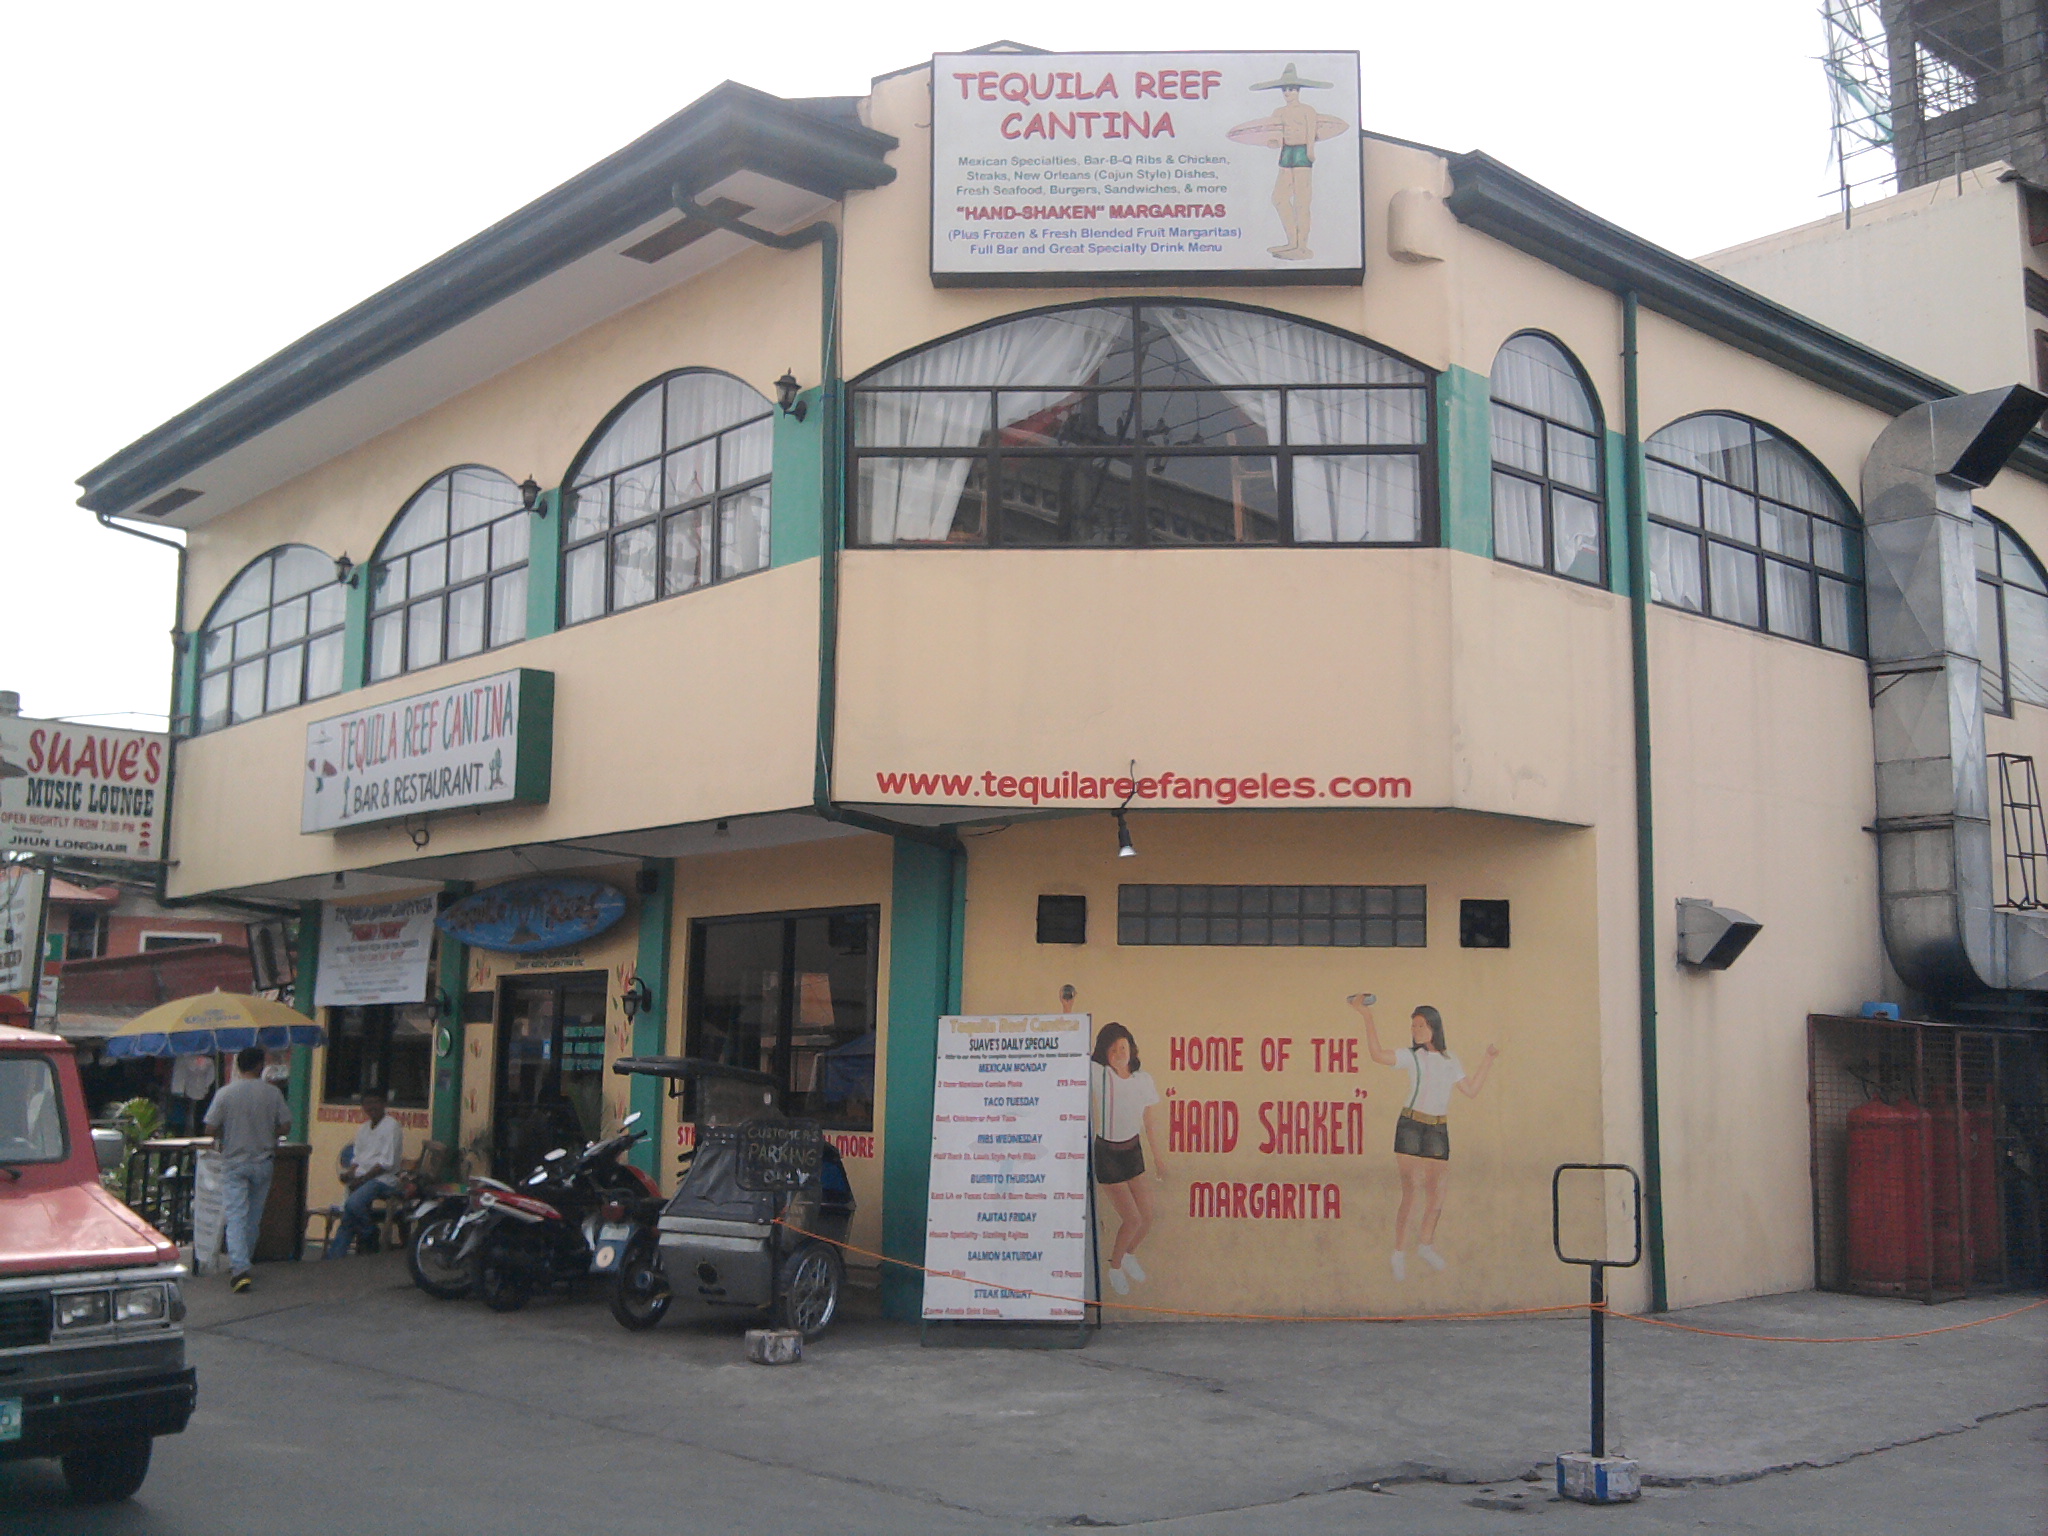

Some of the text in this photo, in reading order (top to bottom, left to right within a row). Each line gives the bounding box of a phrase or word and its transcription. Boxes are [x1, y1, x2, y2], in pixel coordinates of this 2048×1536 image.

[953, 70, 1222, 106] TEQUILA REEF
[1000, 111, 1175, 140] CANTINA
[958, 154, 1231, 168] Mexican Specialties, Bar-B-Q Ribs & Chicken,
[966, 168, 1219, 182] Steaks, New Orleans (Cajun Style) Dishes,
[956, 184, 1228, 198] Fresh Seafood, Burgers, Sandwiches, & more
[1109, 204, 1227, 219] MARGARITAS
[948, 227, 1242, 241] (Plus Frozen & Fresh Blended Fruit Margaritas)
[970, 242, 1223, 255] Full Bar and Great Specialty Drink Menu
[341, 681, 513, 775] TEQUILA REEF CANTINA
[27, 729, 162, 784] SUAVE'S
[354, 763, 484, 814] BAR & RESTAURANT
[876, 771, 1412, 805] www.tequilareefangeles.com
[26, 777, 154, 817] MUSIC LOUNGE
[1, 811, 27, 824] OPEN
[29, 814, 70, 827] NIGHTLY
[73, 817, 98, 831] FROM
[969, 1037, 1059, 1051] SUAVE'S DAILY SPECIALS
[1170, 1036, 1359, 1073] HOME OF THE
[978, 1063, 1047, 1073] MEXICAN MONDAY
[984, 1097, 1039, 1106] TACO TUESDAY
[996, 1134, 1043, 1144] WEDNESDAY
[836, 1135, 875, 1158] MORE
[748, 1142, 817, 1166] PARKING
[1006, 1174, 1046, 1184] THURSDAY
[1190, 1182, 1341, 1219] MARGARITA
[977, 1212, 1037, 1222] FAJITAS FRIDAY
[967, 1251, 1043, 1261] SALMON SATURDAY
[974, 1289, 999, 1299] STEAK
